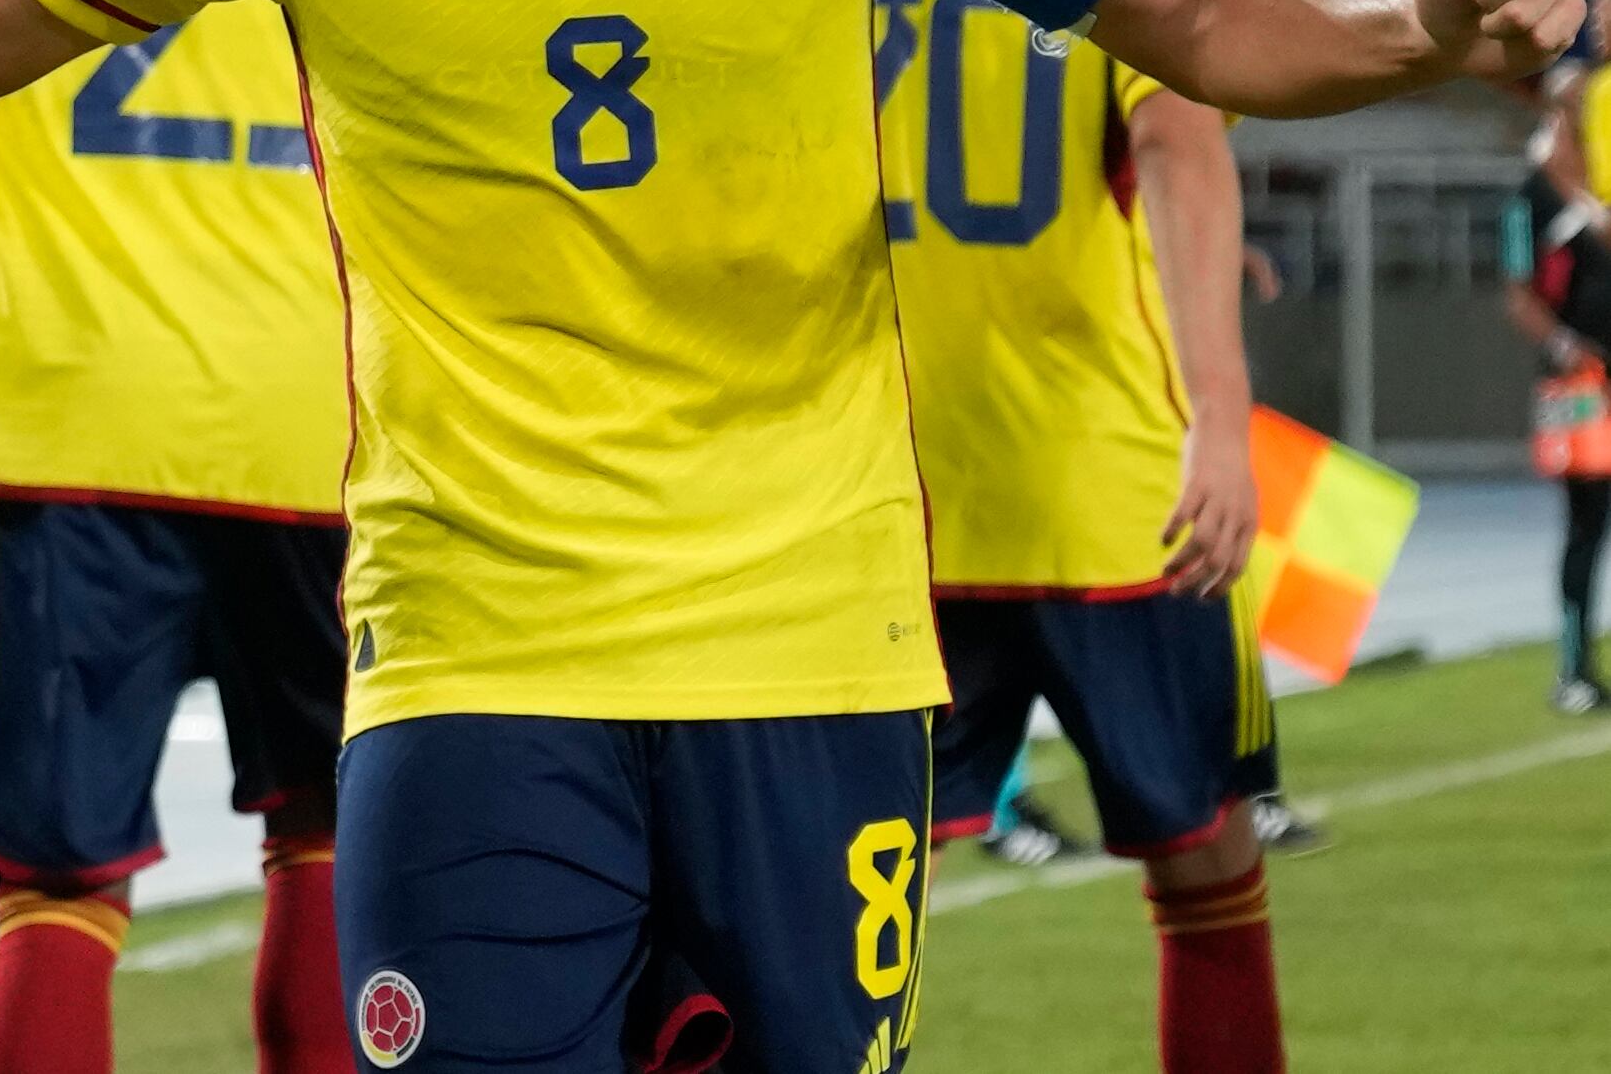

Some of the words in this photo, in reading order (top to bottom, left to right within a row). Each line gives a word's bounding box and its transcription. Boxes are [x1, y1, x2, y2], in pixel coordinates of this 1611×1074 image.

[72, 22, 316, 169] 2
[545, 14, 658, 191] 8
[848, 818, 917, 1000] 8
